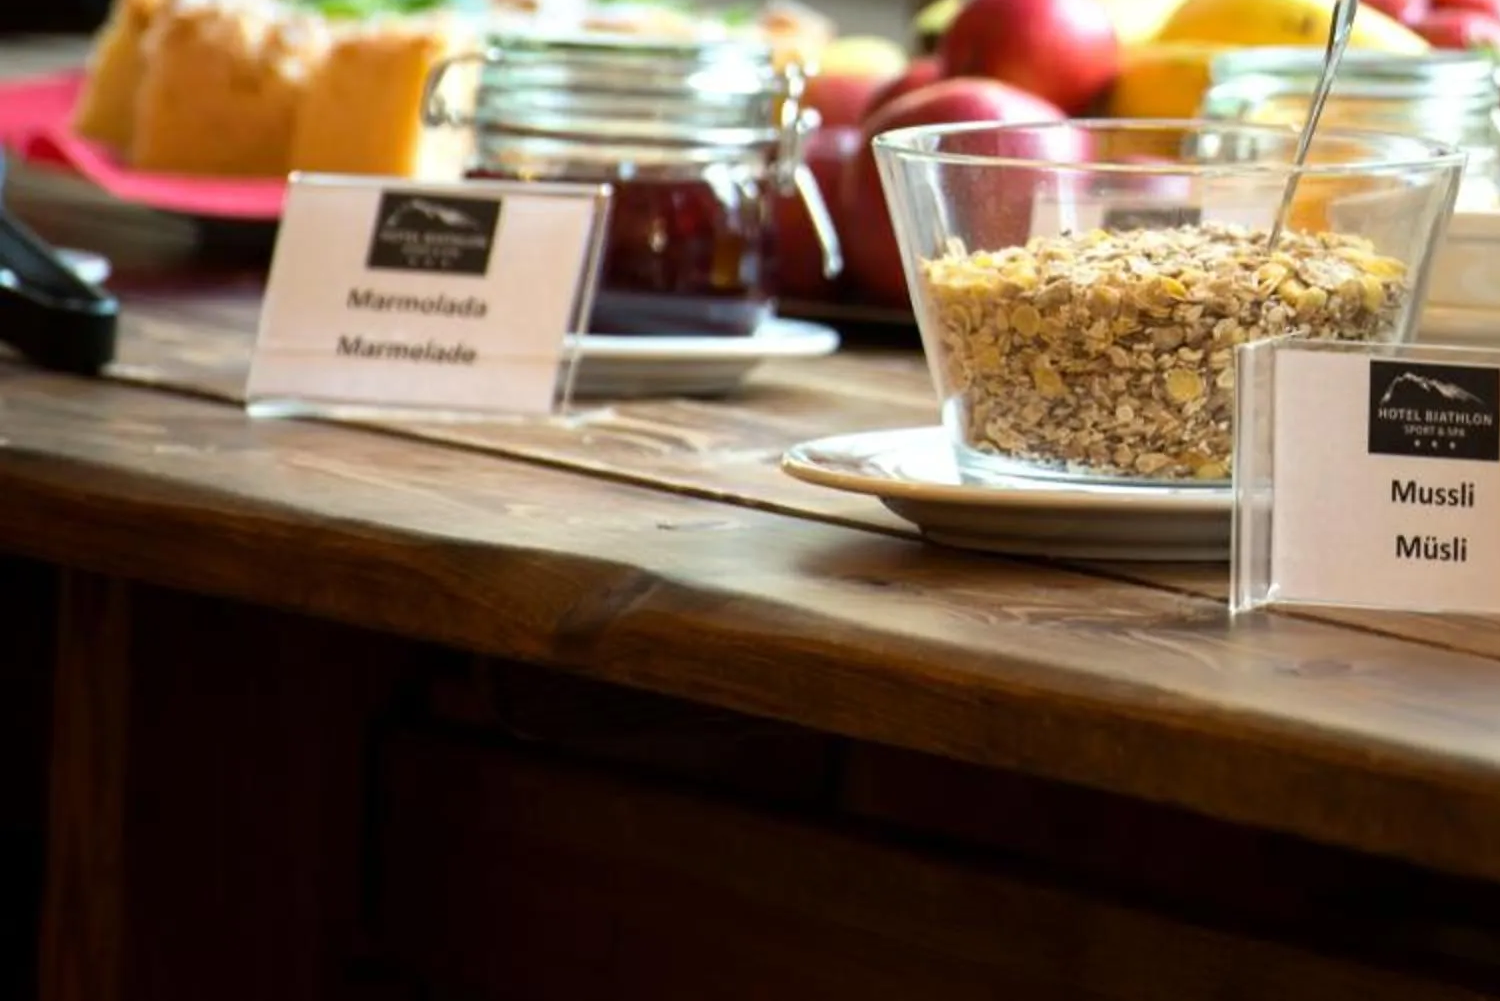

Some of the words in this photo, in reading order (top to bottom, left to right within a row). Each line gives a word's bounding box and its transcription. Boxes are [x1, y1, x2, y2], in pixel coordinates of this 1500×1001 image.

[346, 287, 488, 318] Marmolada
[336, 334, 477, 365] Marmelade
[1378, 408, 1422, 422] HOTEL
[1425, 410, 1493, 426] BIATHLON
[1391, 479, 1475, 508] Mussli
[1396, 534, 1467, 562] Müsli
